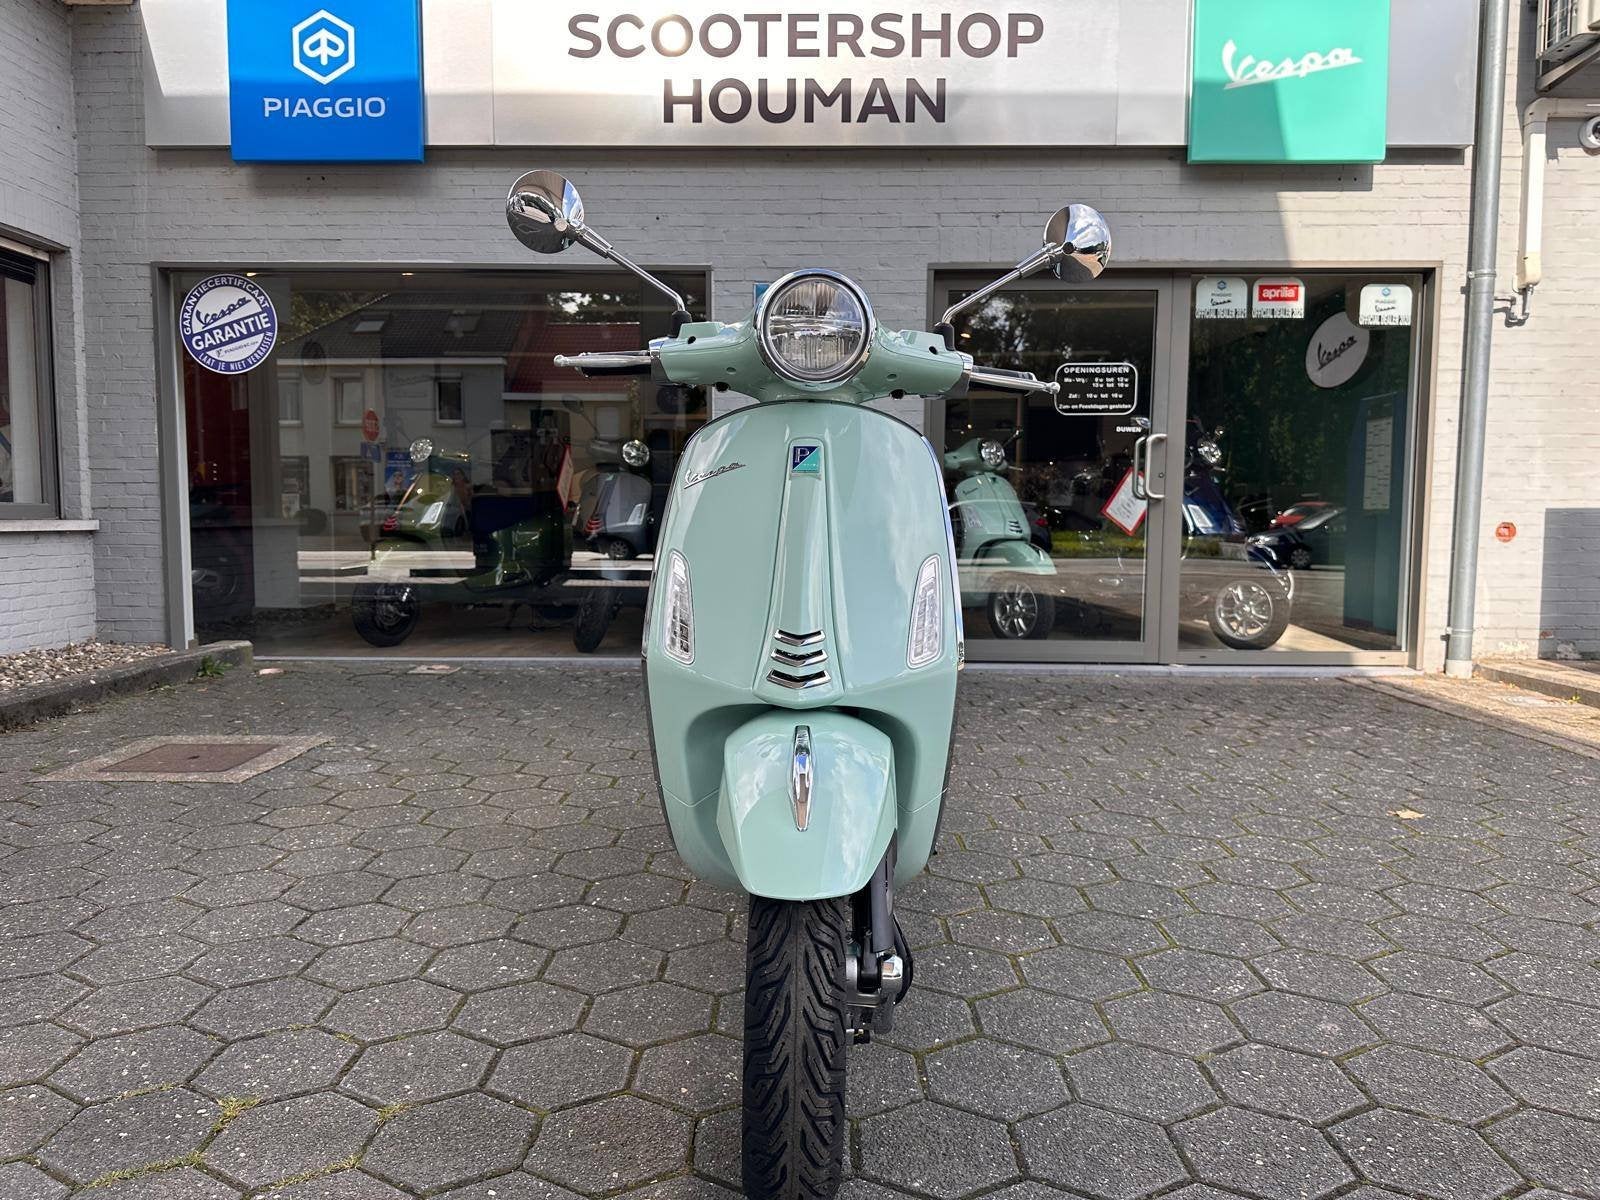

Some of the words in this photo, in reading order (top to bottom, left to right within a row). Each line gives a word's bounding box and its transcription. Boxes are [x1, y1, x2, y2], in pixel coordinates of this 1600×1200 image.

[567, 13, 1045, 58] SCOOTERSHOP
[1222, 38, 1363, 90] Vespa
[263, 97, 386, 118] PIAGGIO
[663, 77, 947, 124] HOUMAN
[183, 276, 270, 335] GARANTIECERTIFICAAT
[1262, 286, 1295, 300] aprilia
[192, 313, 271, 350] GARANTIE
[195, 297, 252, 330] Vespa
[199, 353, 215, 367] LAAT
[218, 361, 226, 371] JE
[230, 360, 246, 371] NIET
[246, 331, 274, 365] VERRASSEN
[1316, 335, 1358, 371] Vespa
[684, 461, 747, 490] Vespa
